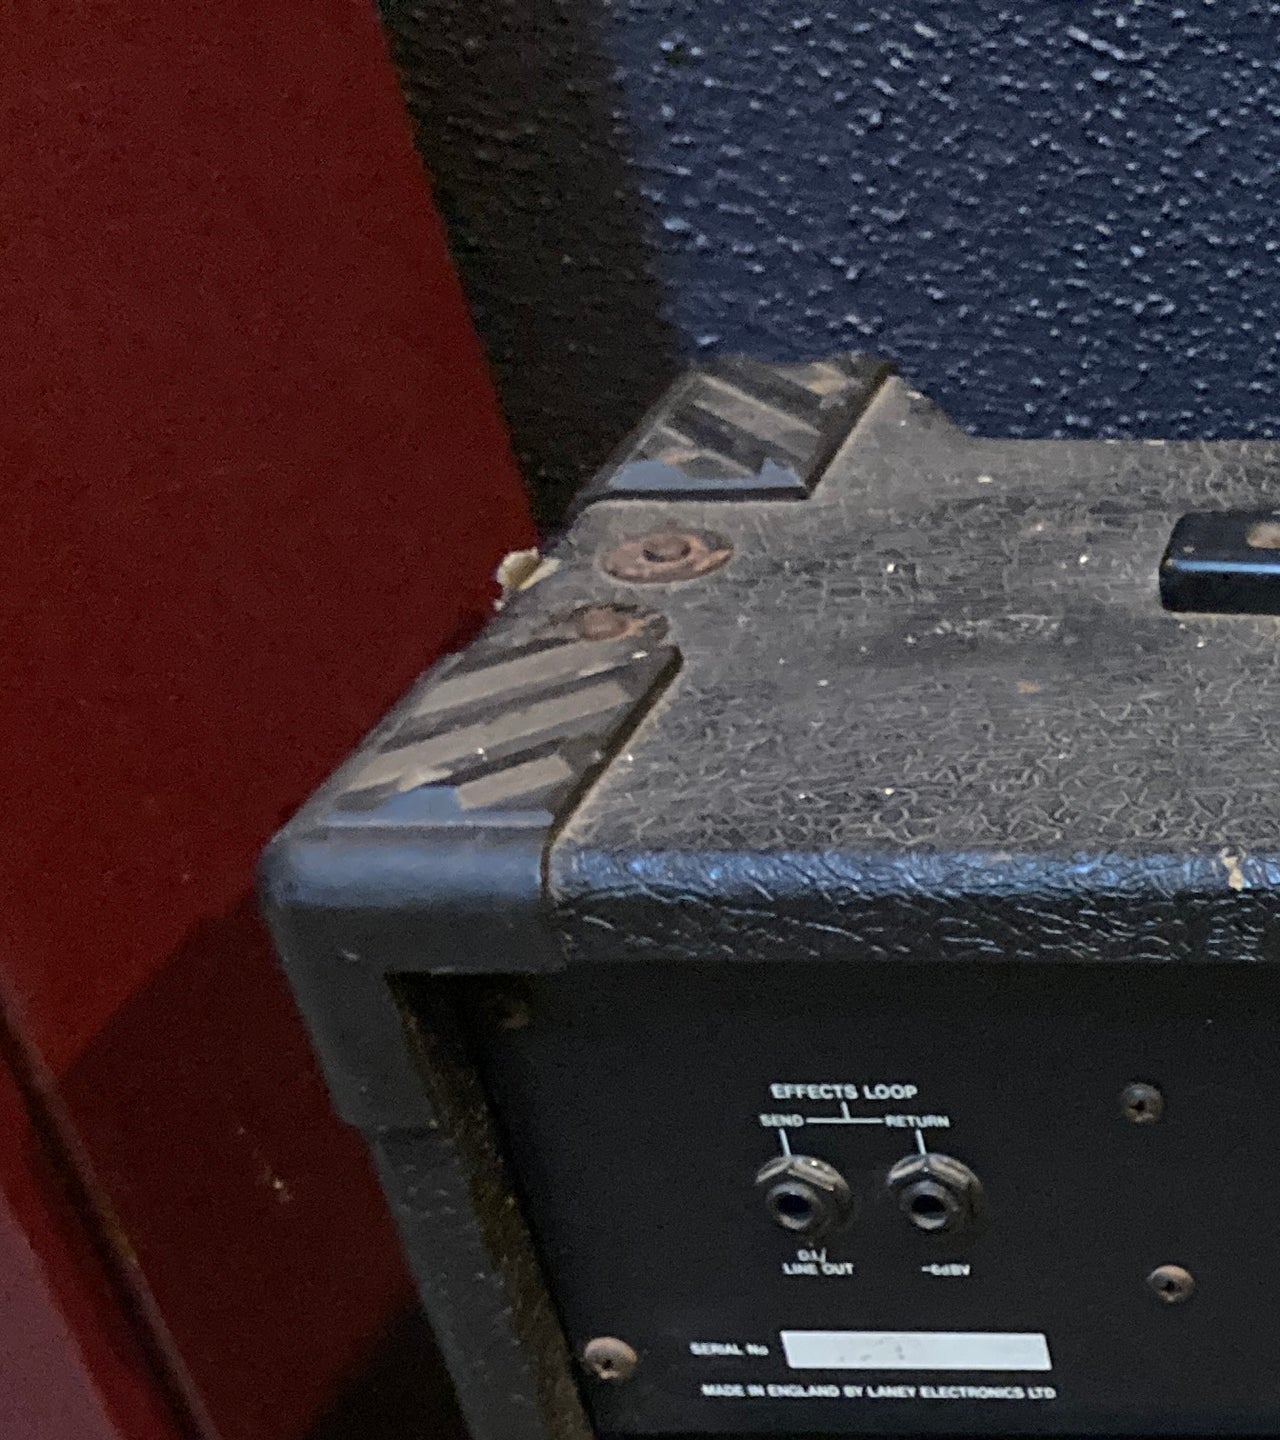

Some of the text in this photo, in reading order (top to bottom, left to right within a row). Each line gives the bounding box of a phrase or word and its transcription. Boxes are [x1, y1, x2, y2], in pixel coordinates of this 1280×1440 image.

[769, 1083, 918, 1099] EFFECTS LOOP
[760, 1114, 950, 1128] SEND RETURN
[782, 1263, 854, 1275] LINE OUT
[690, 1343, 742, 1355] SERIAL
[702, 1384, 1056, 1399] MADE IN ENGLAND BY LANEY ELECTRONICS LTD
